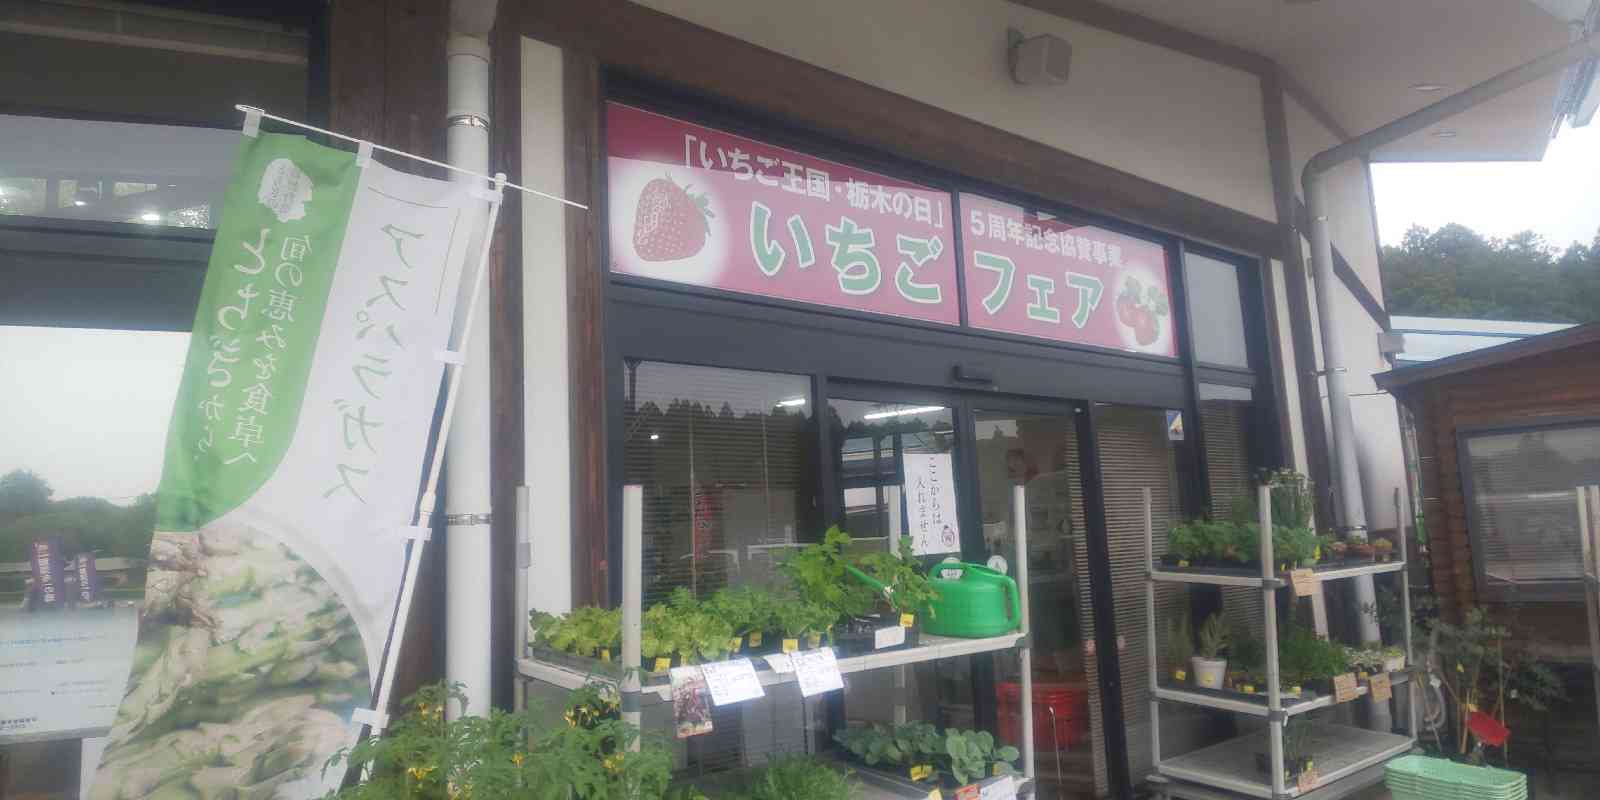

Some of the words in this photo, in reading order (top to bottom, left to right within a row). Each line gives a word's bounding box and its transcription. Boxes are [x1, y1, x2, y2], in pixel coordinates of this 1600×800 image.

[749, 202, 944, 305] いちご
[973, 250, 1104, 329] フェア
[917, 475, 929, 548] 入れません
[929, 457, 942, 525] ここからは
